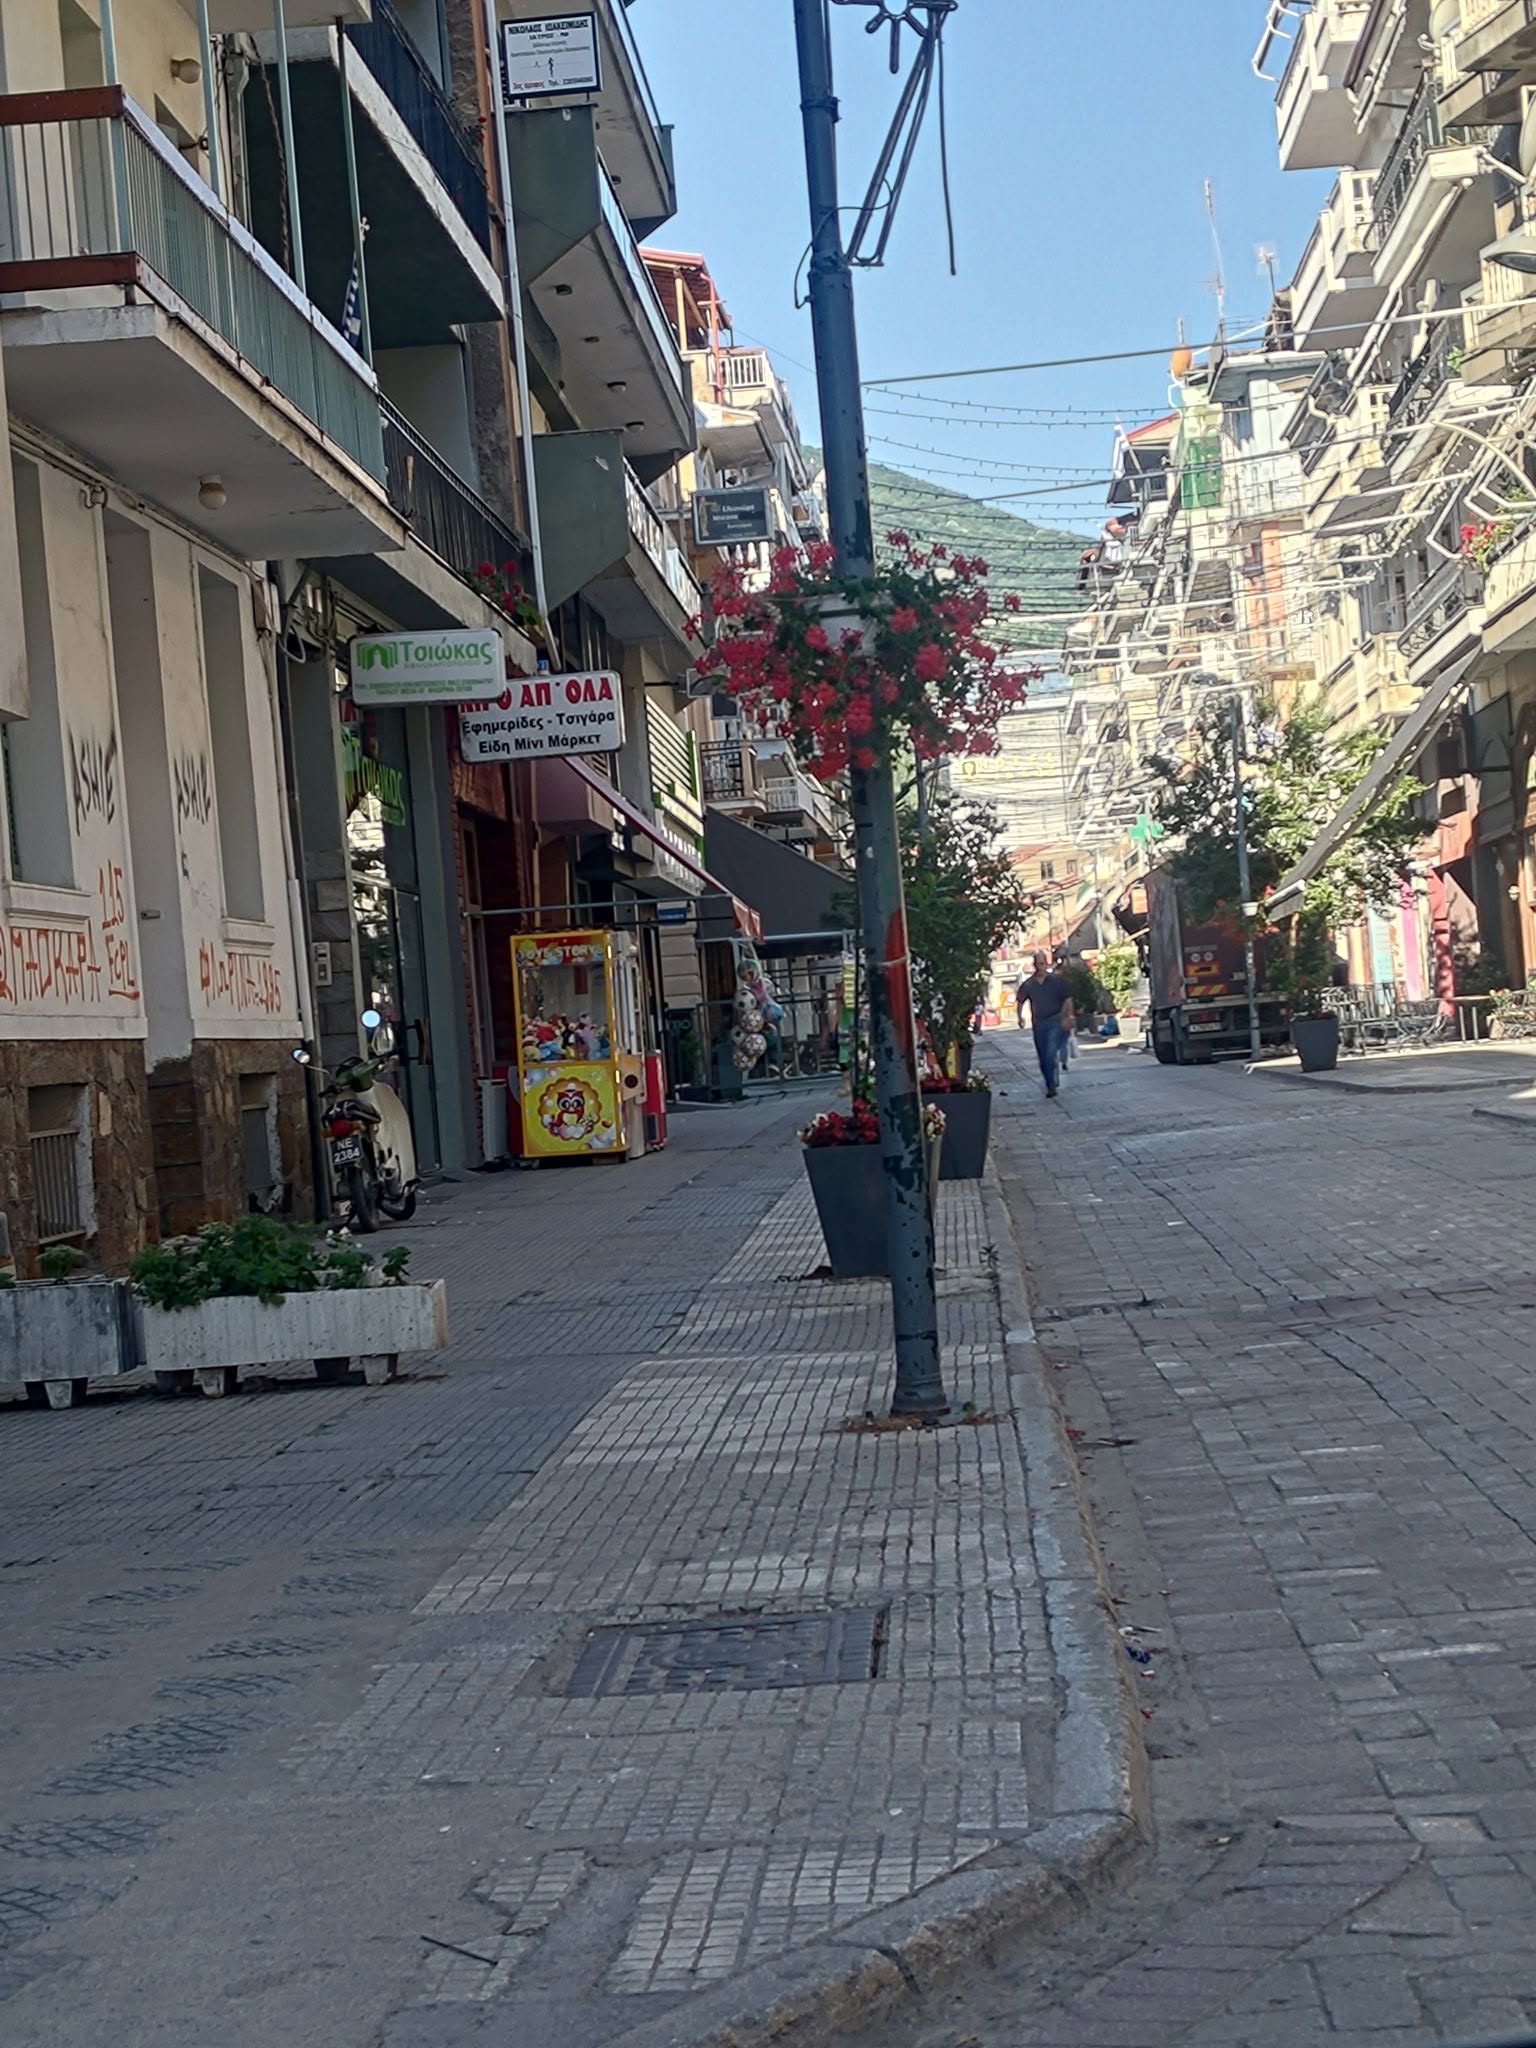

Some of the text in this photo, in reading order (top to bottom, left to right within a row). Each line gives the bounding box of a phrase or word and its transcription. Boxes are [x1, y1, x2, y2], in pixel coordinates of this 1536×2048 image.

[400, 636, 493, 665] Τσιώκας
[462, 716, 544, 736] Εφημερίδες
[556, 711, 615, 727] Τσιγάρα
[479, 734, 602, 755] Είδη Μίνι Μάρκετ
[333, 1147, 360, 1163] 2384
